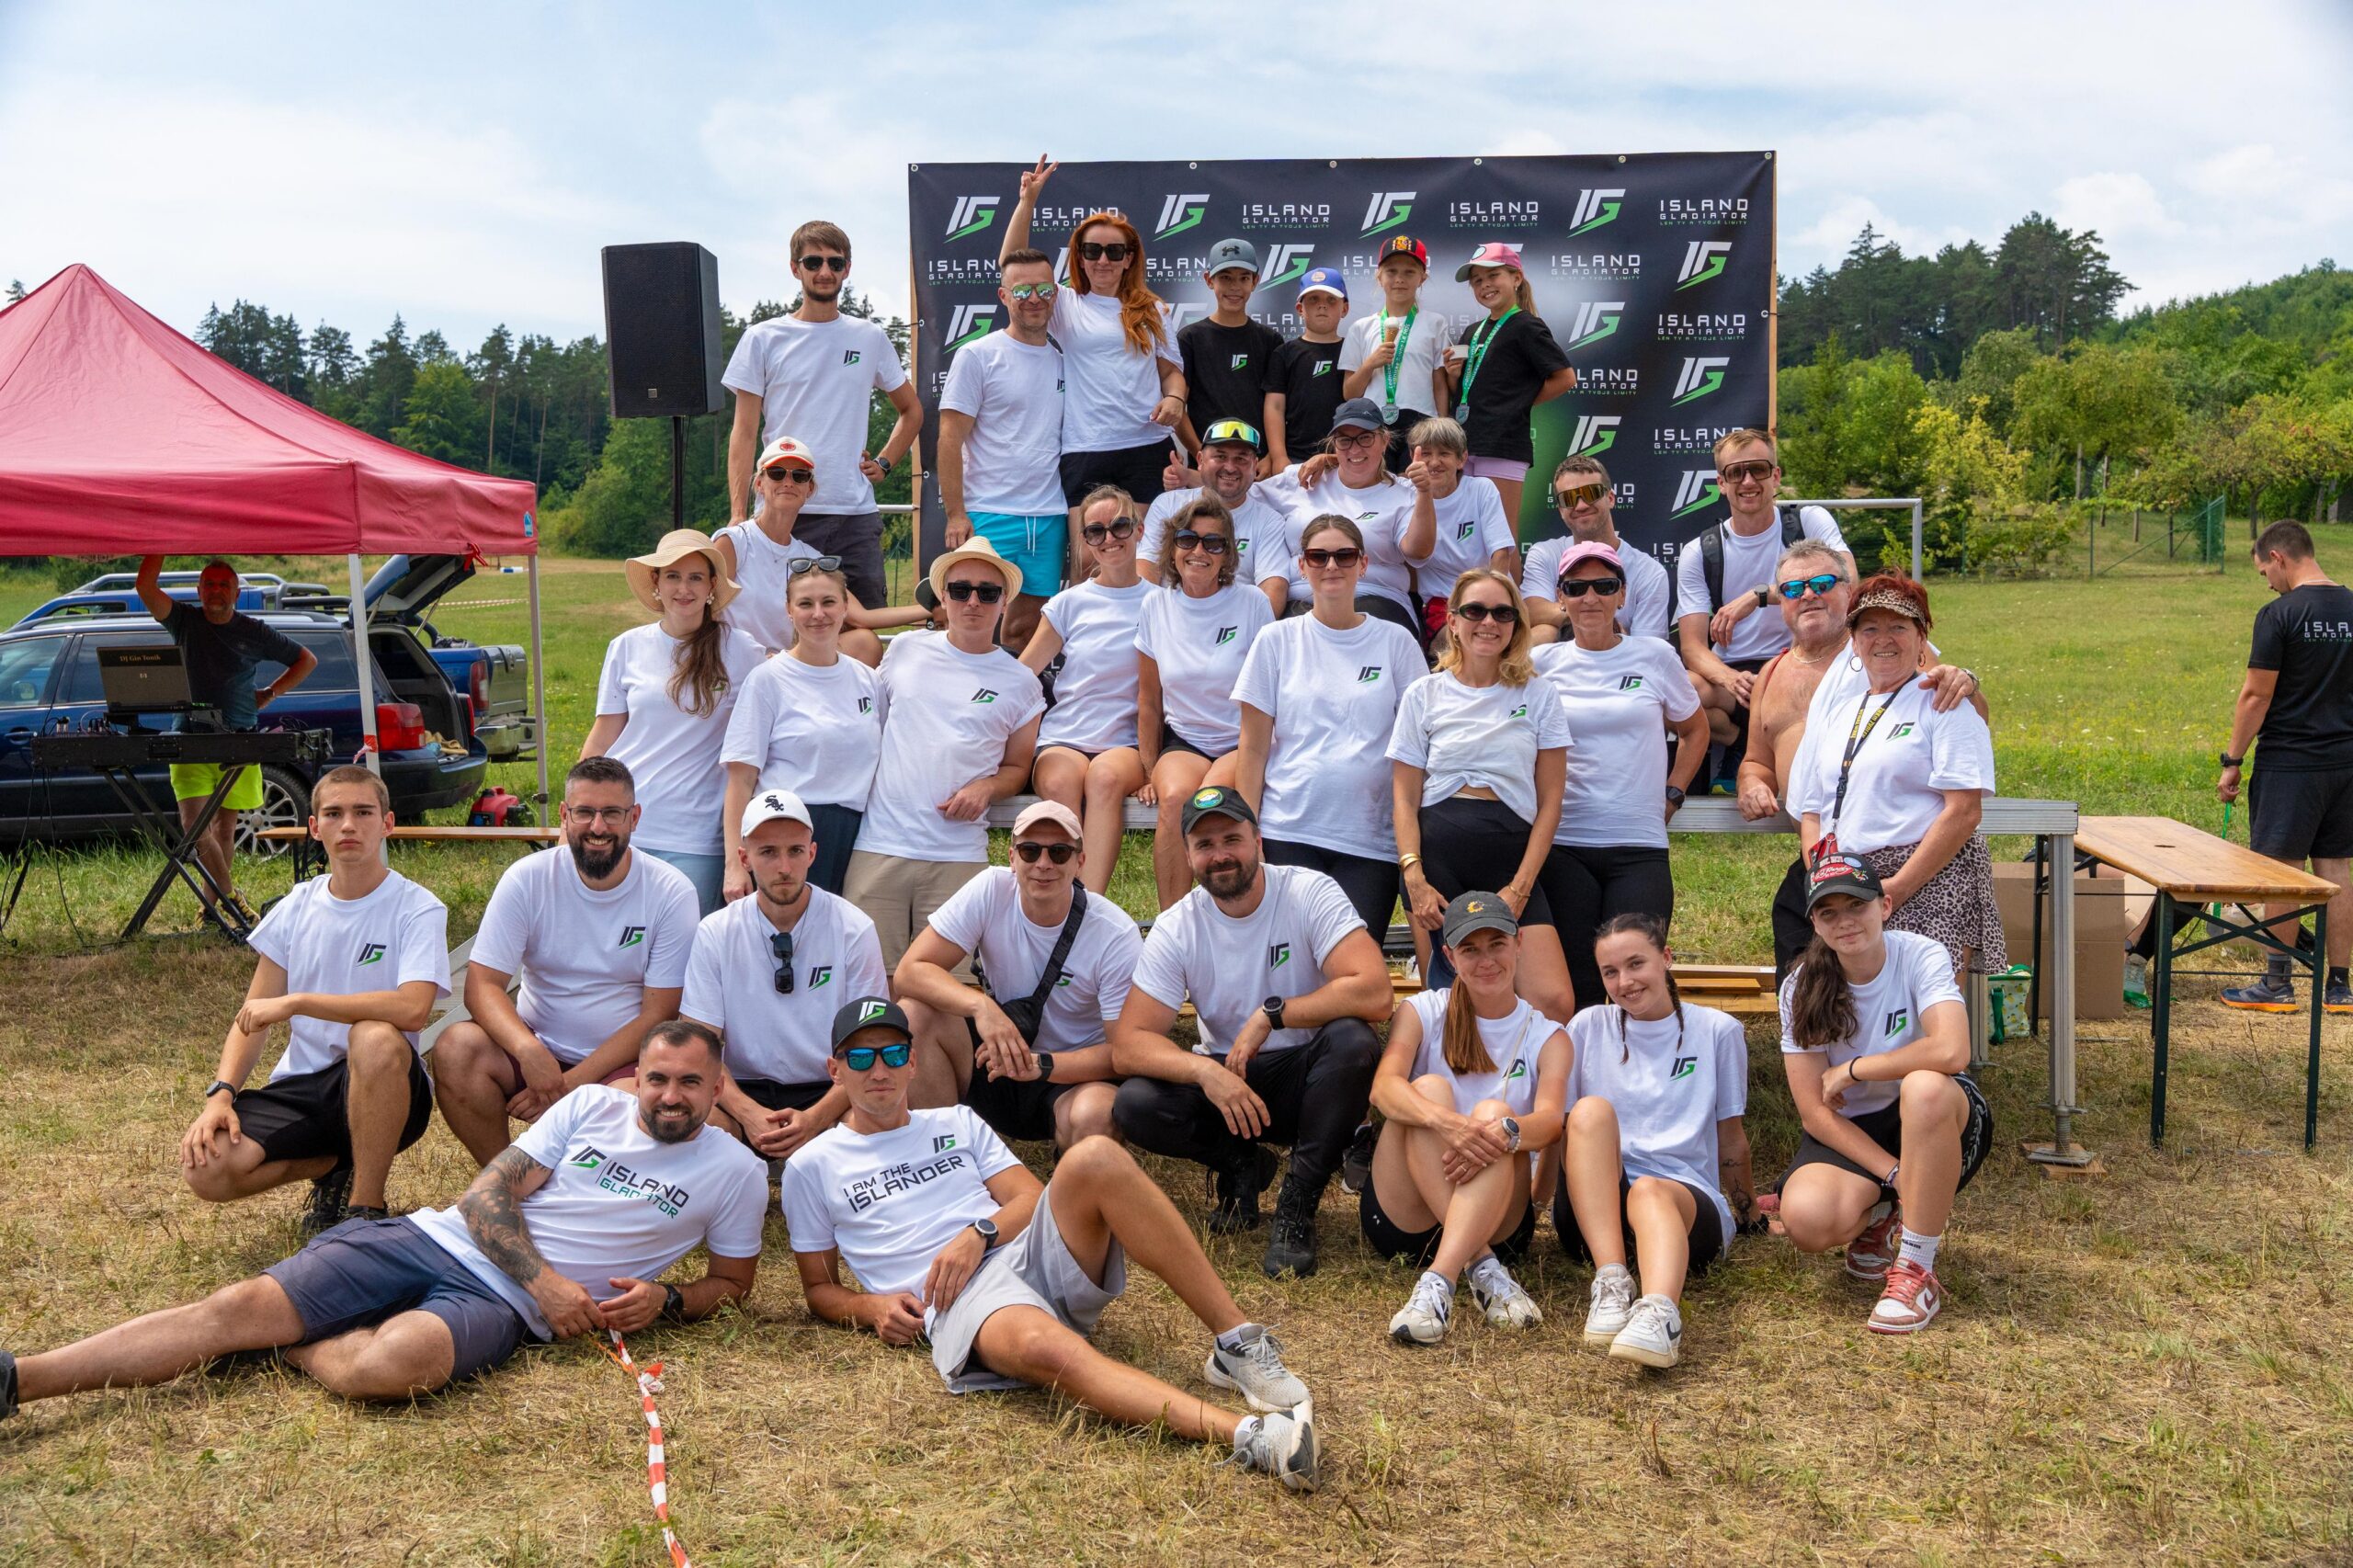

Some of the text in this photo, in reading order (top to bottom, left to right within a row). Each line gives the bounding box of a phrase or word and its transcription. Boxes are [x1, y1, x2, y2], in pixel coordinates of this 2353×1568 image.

[1243, 204, 1330, 216] ISLAND
[1450, 201, 1539, 214] ISLAND
[1660, 199, 1748, 211] ISLAND
[929, 259, 996, 273] ISLAN
[1146, 257, 1206, 269] SLAN
[1552, 255, 1641, 267] ISLAND
[928, 272, 1002, 280] GLADIATO
[1658, 314, 1745, 327] ISLAND
[1576, 369, 1638, 381] LAND
[2304, 621, 2349, 632] ISLA
[607, 1162, 689, 1208] ISLAND
[844, 1163, 912, 1198] I AM THE
[848, 1155, 967, 1213] ISLANDER
